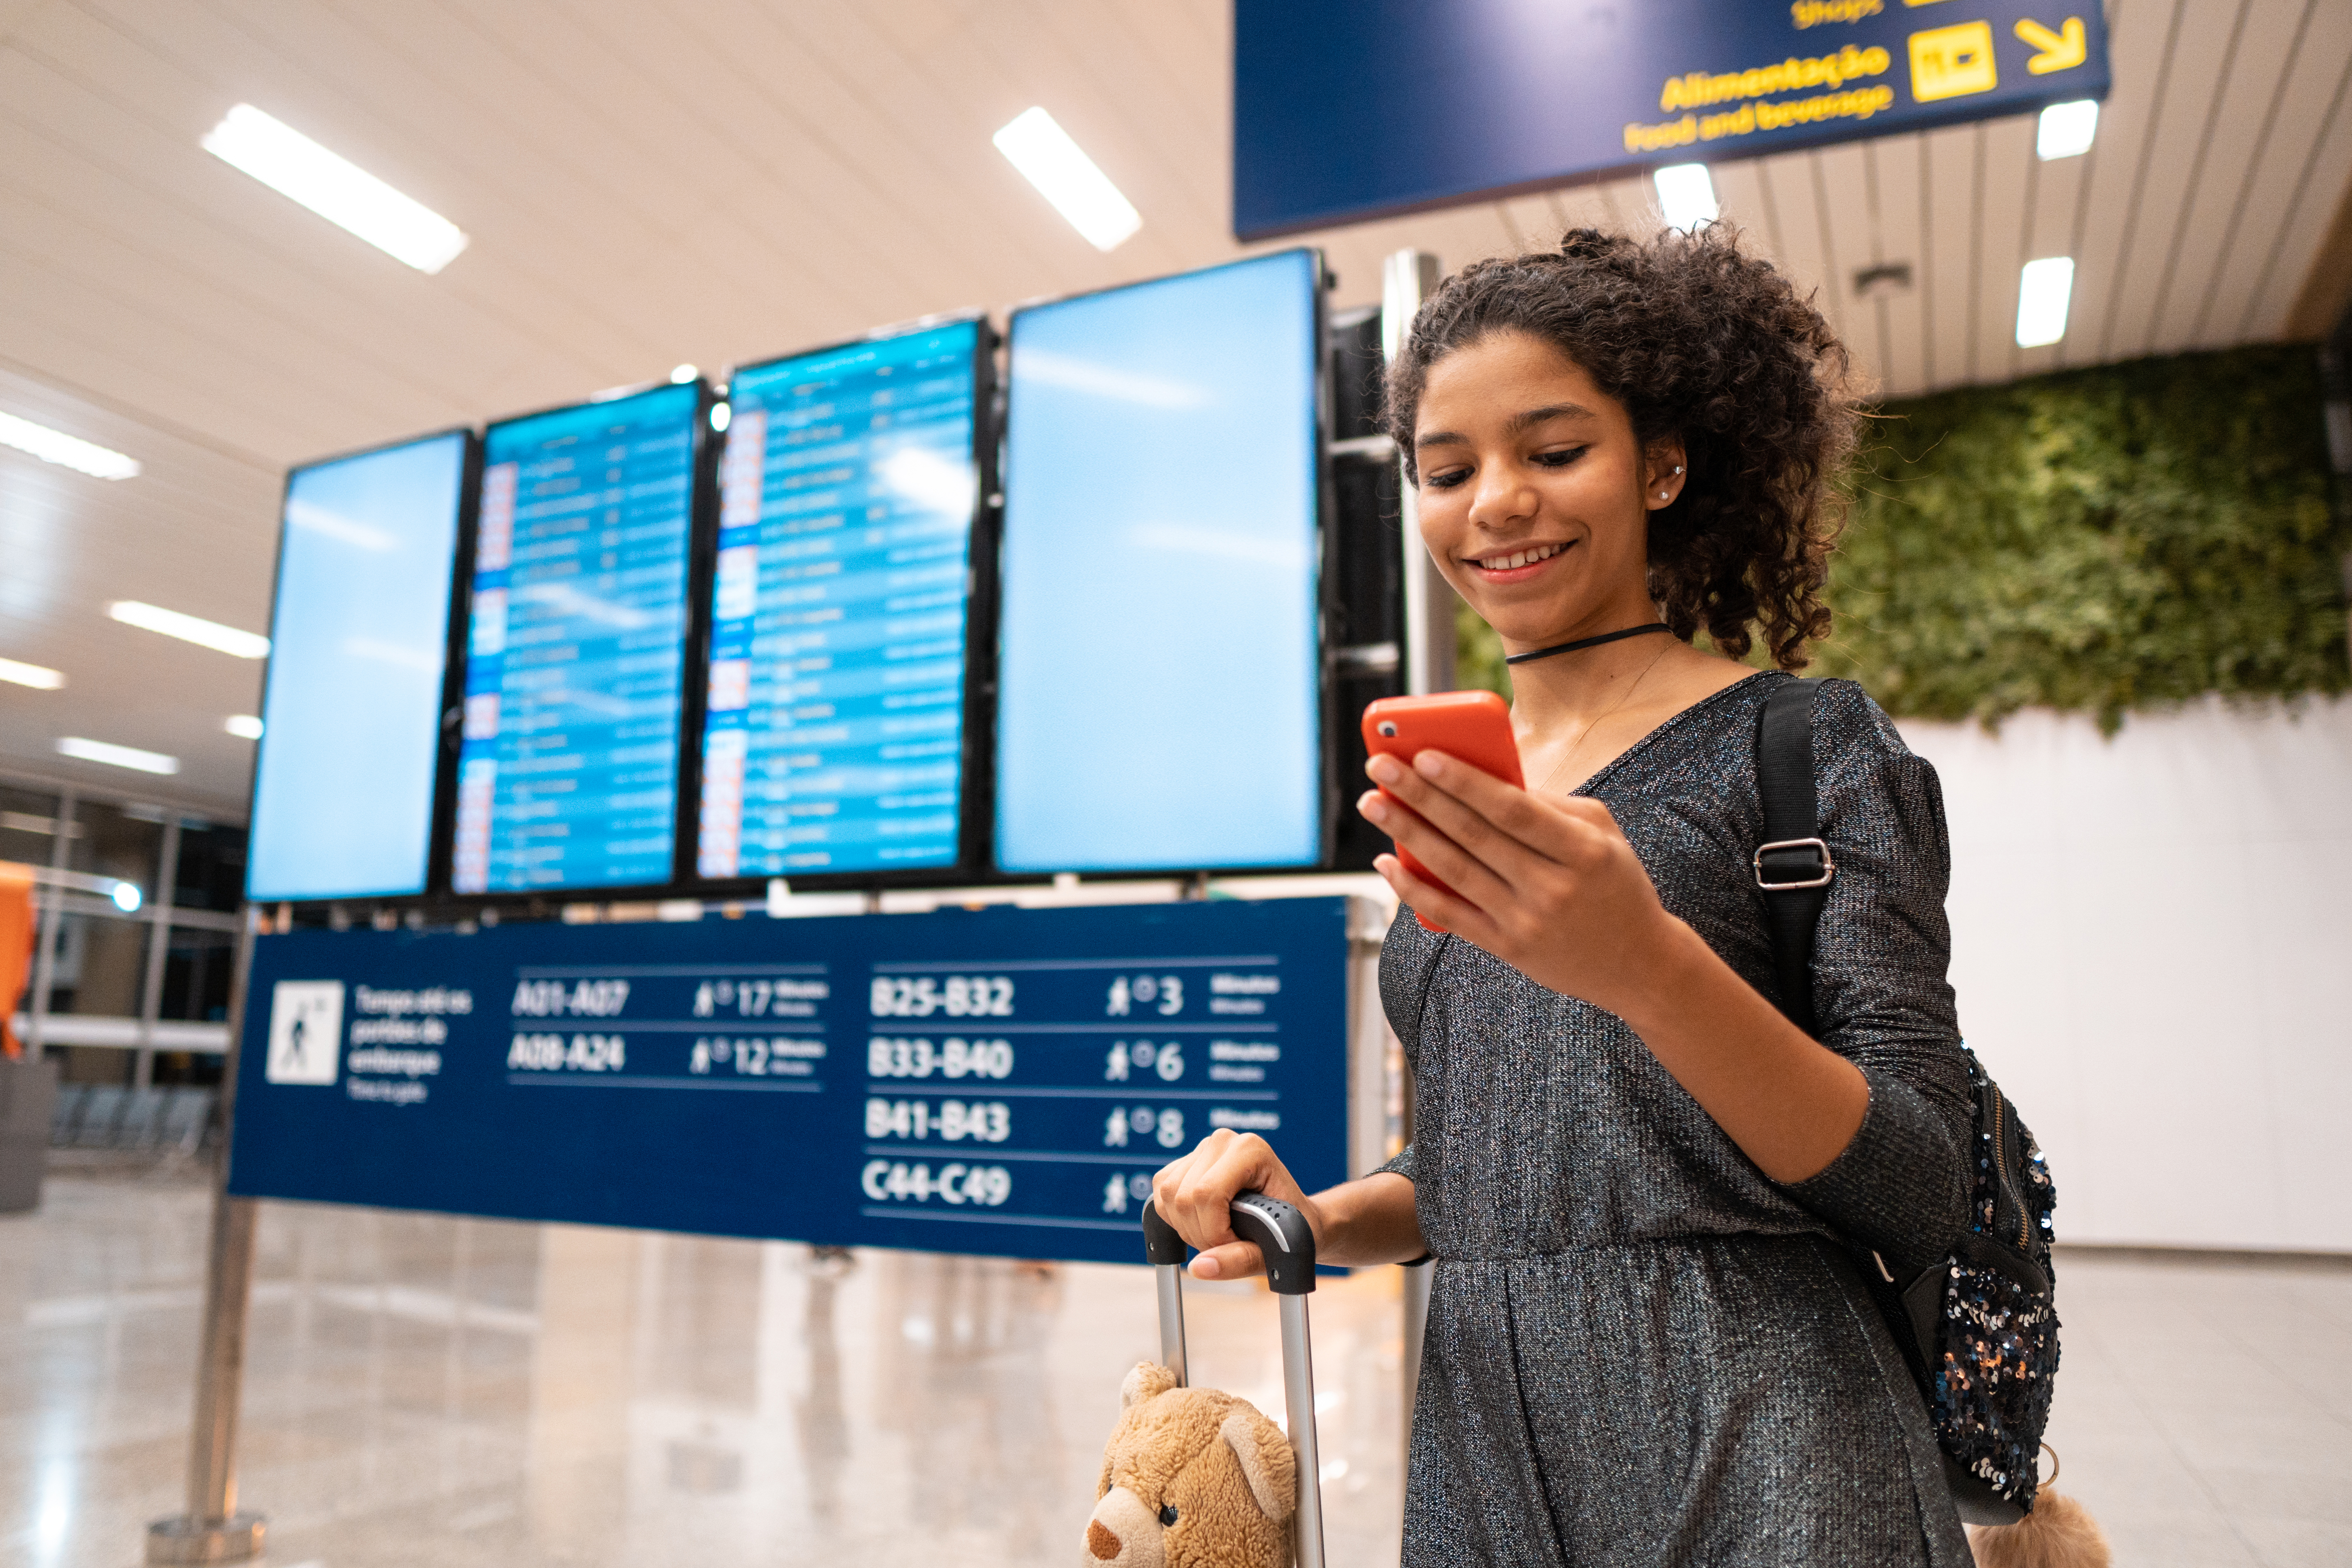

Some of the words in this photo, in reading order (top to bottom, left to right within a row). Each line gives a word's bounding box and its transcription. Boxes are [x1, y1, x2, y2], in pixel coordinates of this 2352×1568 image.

[1660, 45, 1892, 112] Alimentação
[1625, 113, 1697, 153] Food
[1698, 103, 1755, 141] and
[1756, 85, 1894, 130] beverage
[512, 980, 629, 1016] A01-A07
[739, 980, 771, 1016] 17
[870, 977, 1014, 1016] B25-B32
[1158, 976, 1183, 1015] 3
[507, 1034, 625, 1071] A08-A24
[735, 1038, 769, 1075] 12
[868, 1038, 1014, 1079] B33-B40
[1156, 1042, 1184, 1081] 6
[865, 1098, 1010, 1142] B41-B43
[1157, 1108, 1185, 1148] 8
[862, 1160, 1011, 1206] C44-C49
